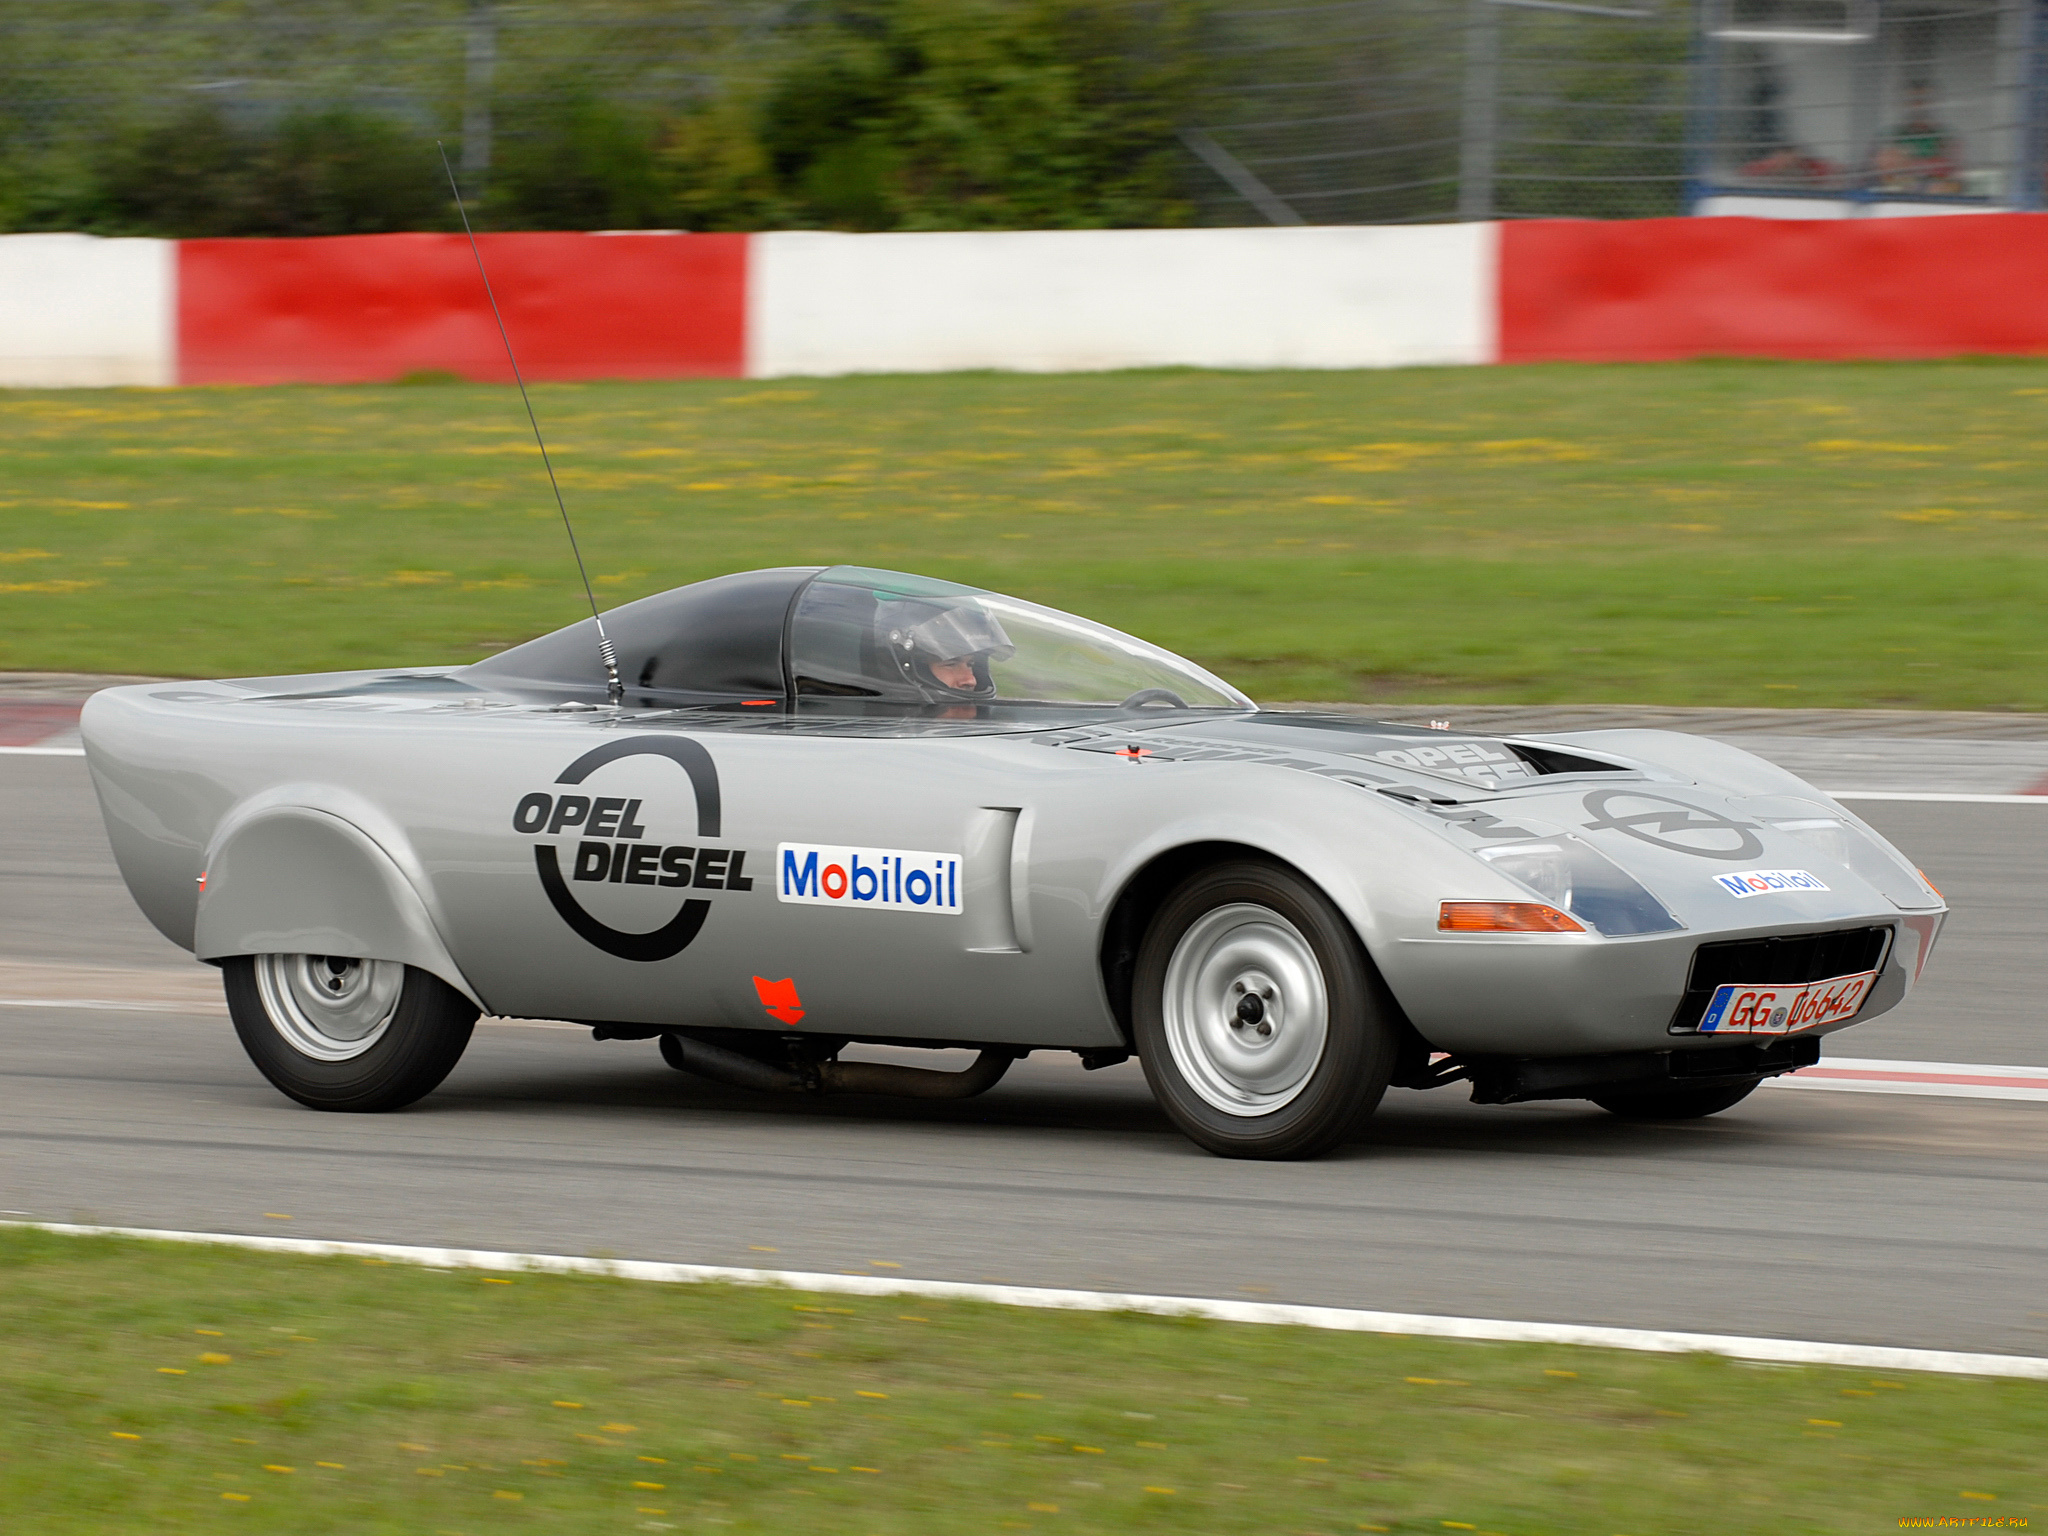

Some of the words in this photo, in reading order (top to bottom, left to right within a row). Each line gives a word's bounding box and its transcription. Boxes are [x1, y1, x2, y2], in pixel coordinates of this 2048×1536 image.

[1375, 743, 1507, 768] OPEL
[512, 792, 646, 839] OPEL
[572, 840, 754, 892] DIESEL
[783, 849, 956, 908] Mobiloil
[1719, 871, 1825, 896] Mobiloil
[1728, 992, 1777, 1027] GG
[1786, 980, 1865, 1027] 06642
